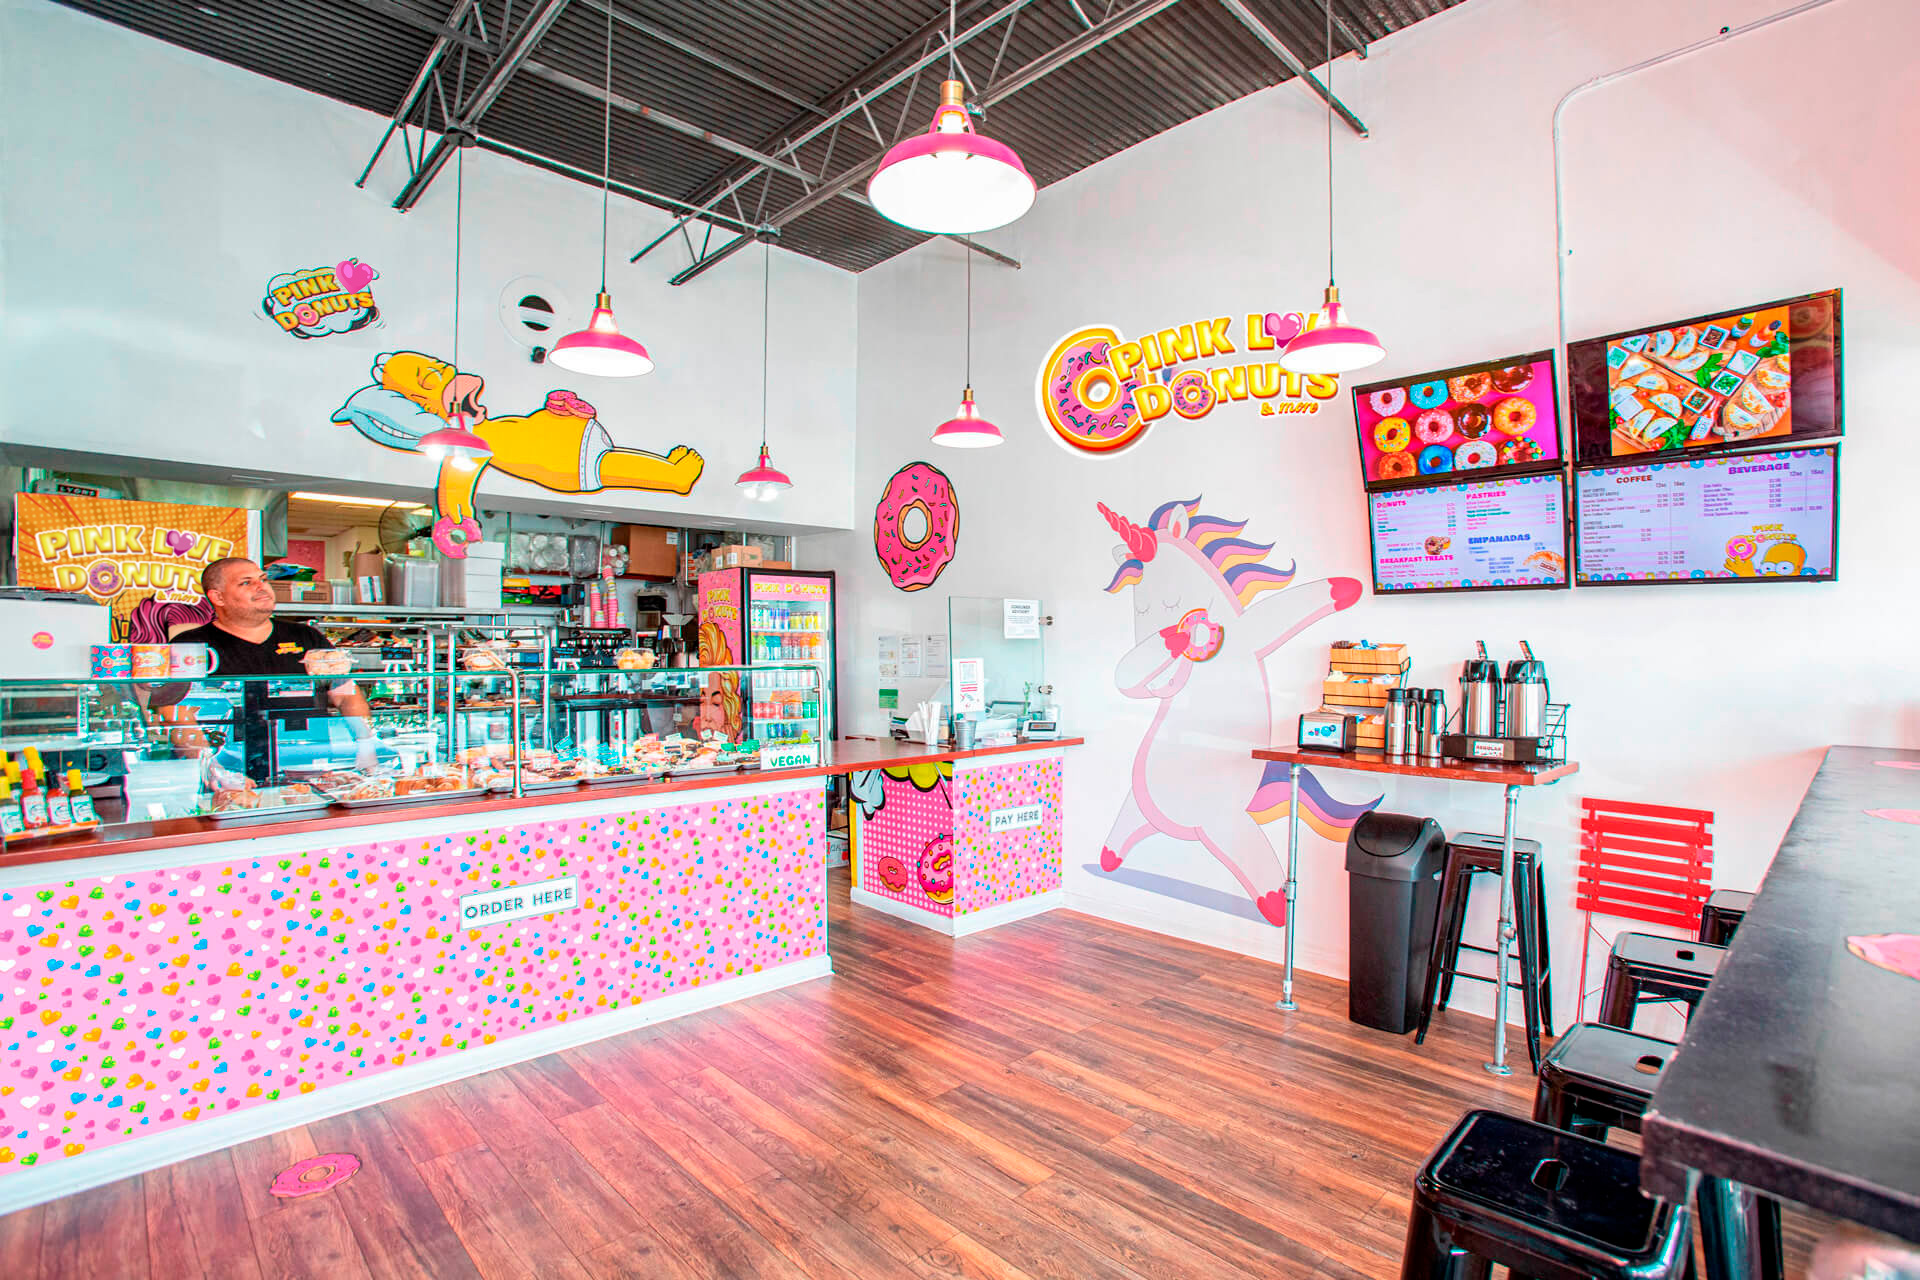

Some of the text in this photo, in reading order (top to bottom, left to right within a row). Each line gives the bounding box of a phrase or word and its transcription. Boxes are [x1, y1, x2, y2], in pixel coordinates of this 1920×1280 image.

[272, 274, 341, 307] PINK
[274, 292, 375, 332] DONUTS
[1109, 317, 1235, 382] PINK
[1134, 363, 1340, 421] DONUTS
[1261, 402, 1275, 416] &
[1728, 463, 1790, 475] BEVERAGE
[1616, 475, 1653, 484] COFFEE
[1466, 490, 1507, 500] PASTRIES
[1376, 500, 1407, 509] DONUTS
[38, 526, 145, 561] PINK
[1468, 533, 1531, 545] EMPANADAS
[1379, 556, 1423, 564] BREAKFAST
[754, 583, 780, 593] PINK
[706, 588, 731, 605] PINK
[769, 754, 811, 768] VEGAN
[995, 809, 1039, 827] PAY HERE
[464, 887, 573, 919] ORDER HERE
